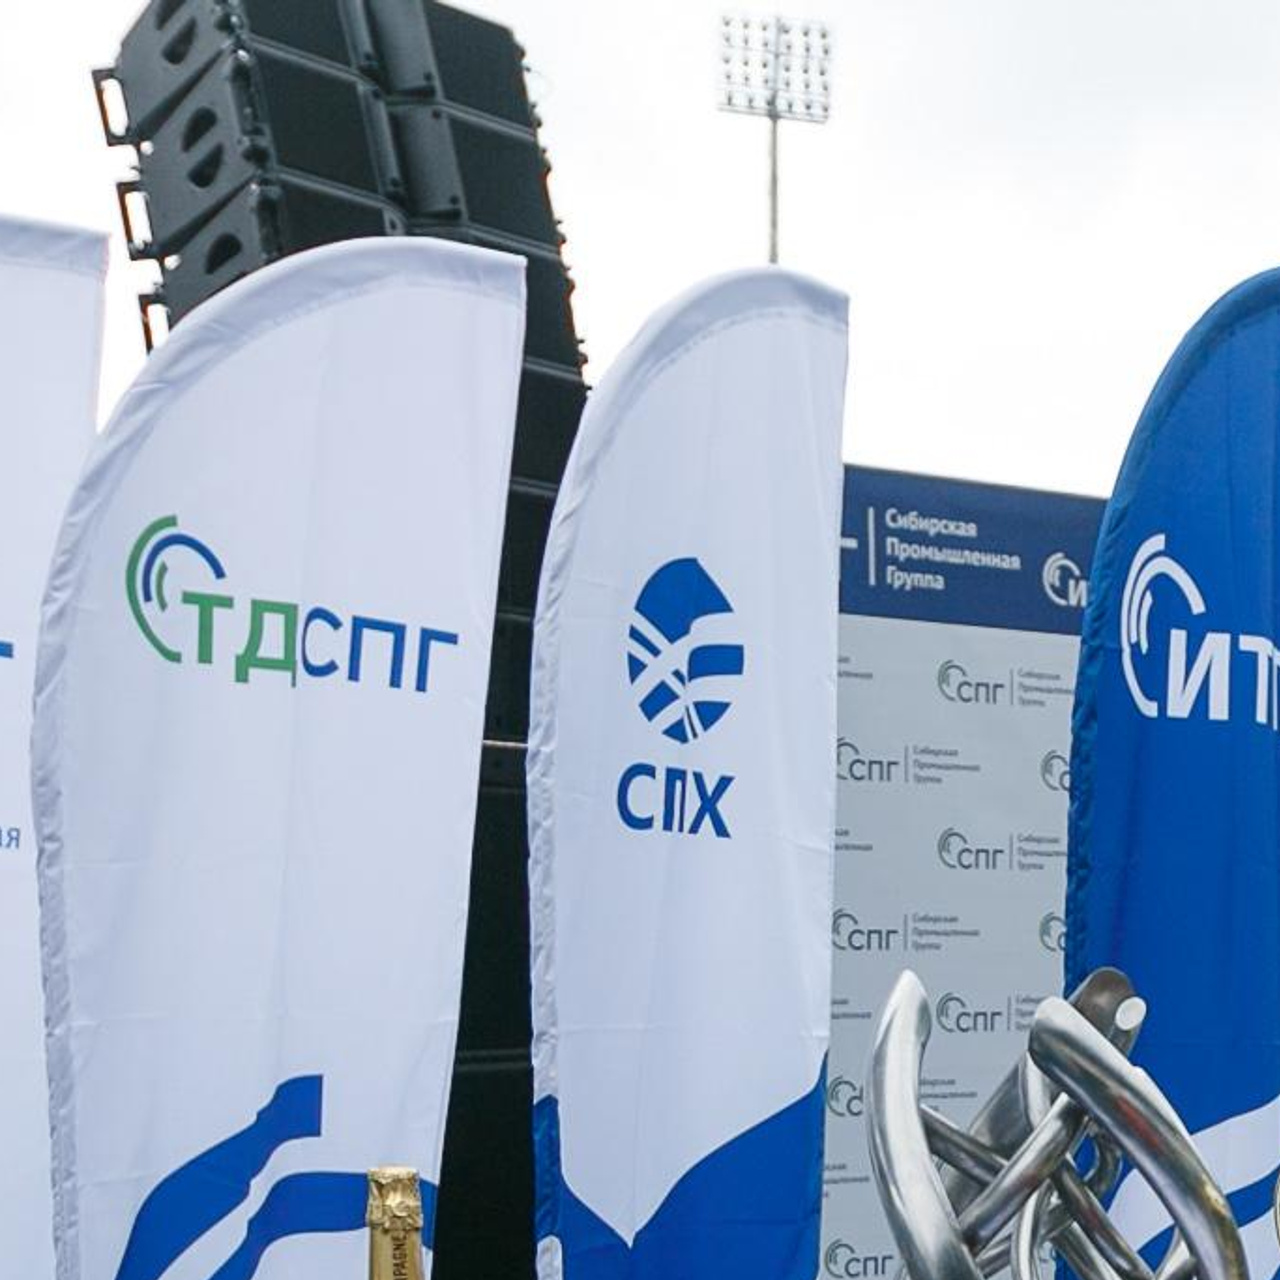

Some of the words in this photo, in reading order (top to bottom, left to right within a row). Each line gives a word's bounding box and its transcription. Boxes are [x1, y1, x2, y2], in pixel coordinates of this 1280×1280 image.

[885, 508, 978, 538] Сибирская
[886, 537, 1021, 570] Промышленная
[886, 566, 945, 591] Группа
[181, 588, 458, 693] ТДСПГ
[956, 682, 1005, 704] СПГ
[849, 759, 899, 782] СПГ
[616, 762, 735, 839] СПХ
[957, 848, 1004, 870] СПГ
[848, 929, 899, 951] СПГ
[956, 1010, 1002, 1033] СПГ
[845, 1255, 894, 1278] СПГ
